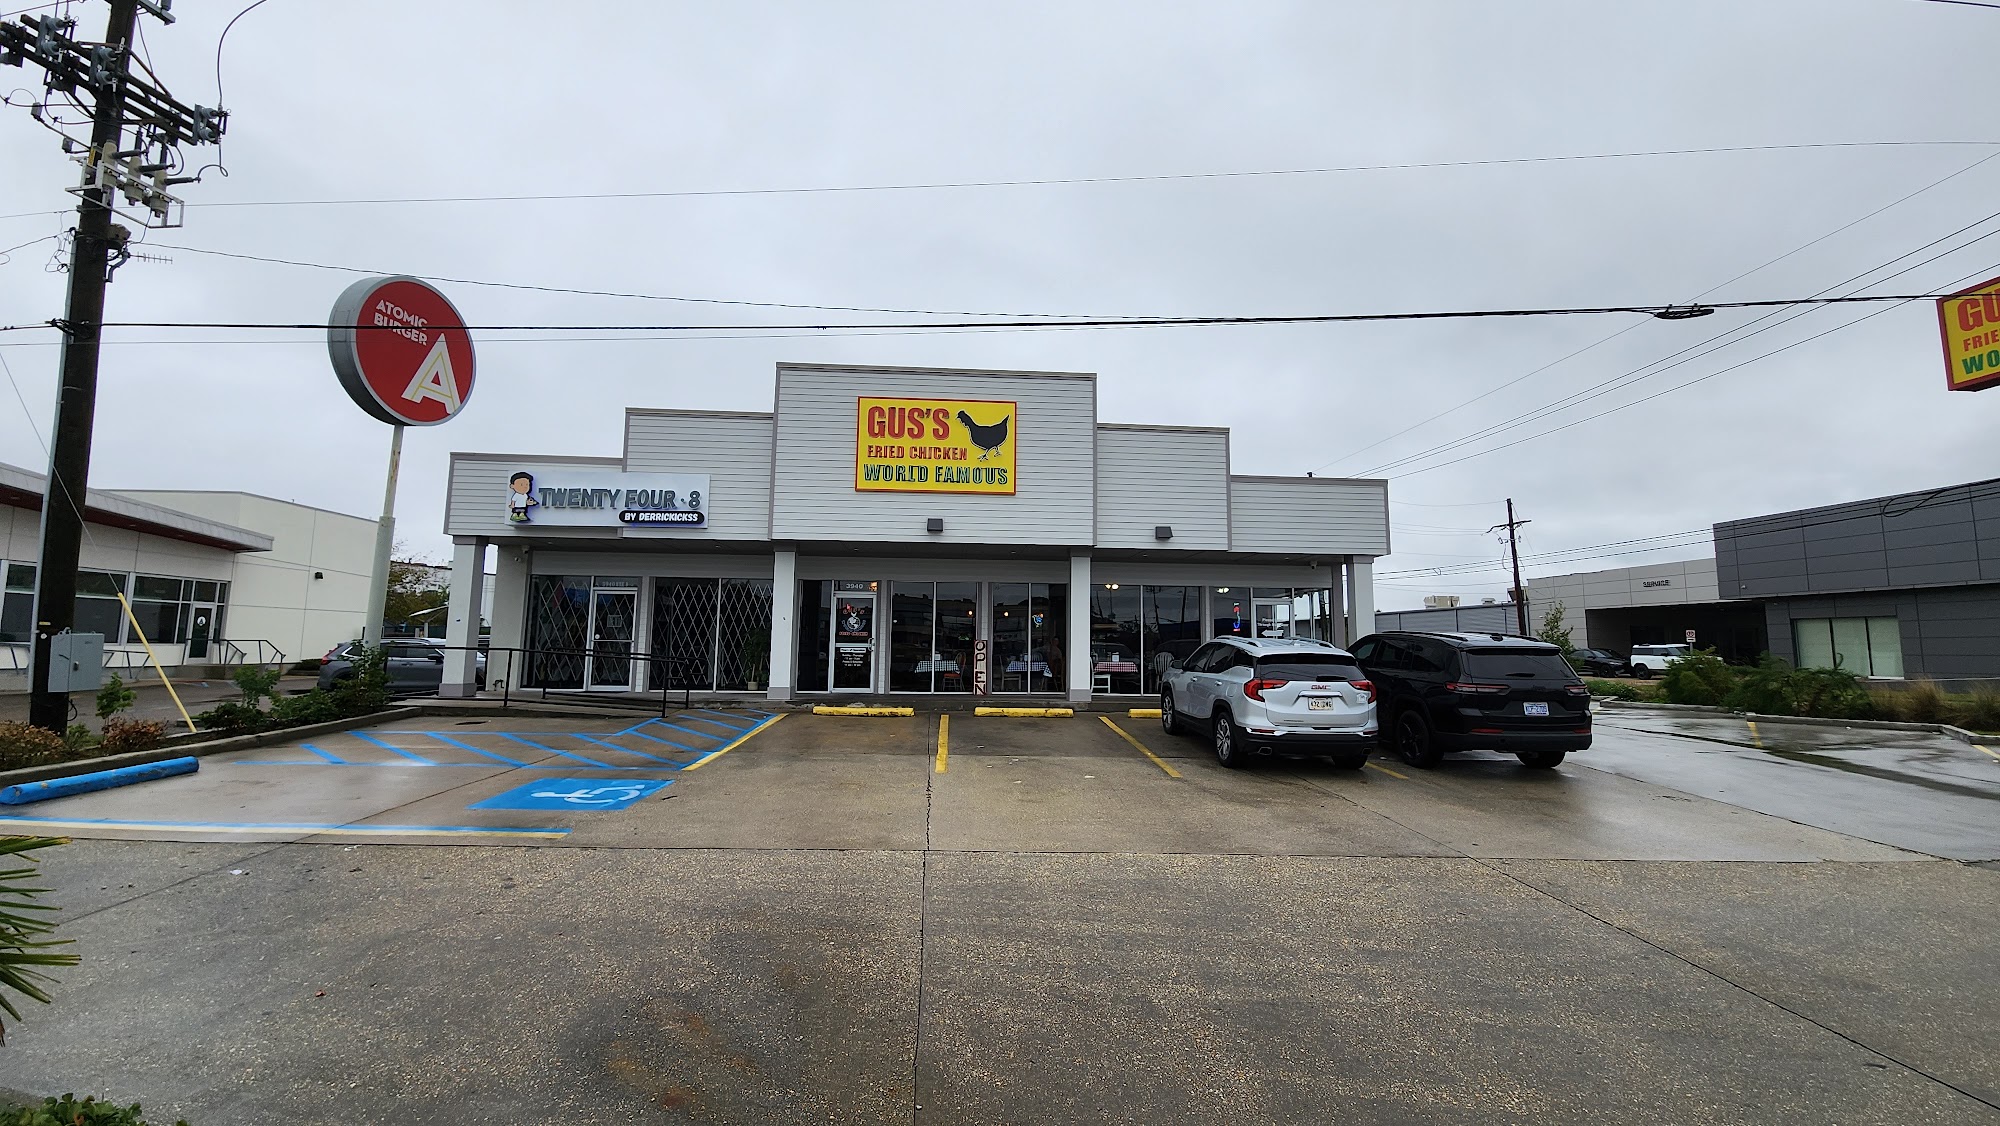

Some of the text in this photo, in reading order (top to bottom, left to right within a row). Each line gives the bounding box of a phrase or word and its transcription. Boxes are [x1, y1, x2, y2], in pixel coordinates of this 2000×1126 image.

[374, 313, 428, 346] BURGER
[376, 300, 428, 331] ATOMIC
[401, 333, 462, 415] A
[1962, 349, 2000, 375] WO
[867, 406, 950, 440] GUS'S
[867, 445, 968, 460] FRIED CHICKEN
[864, 464, 1008, 484] WORLD FAMOUS
[538, 487, 621, 509] TWENTY
[624, 489, 676, 509] FOUR
[625, 513, 698, 522] BY DERRICKICKSS
[975, 641, 986, 695] OPEN
